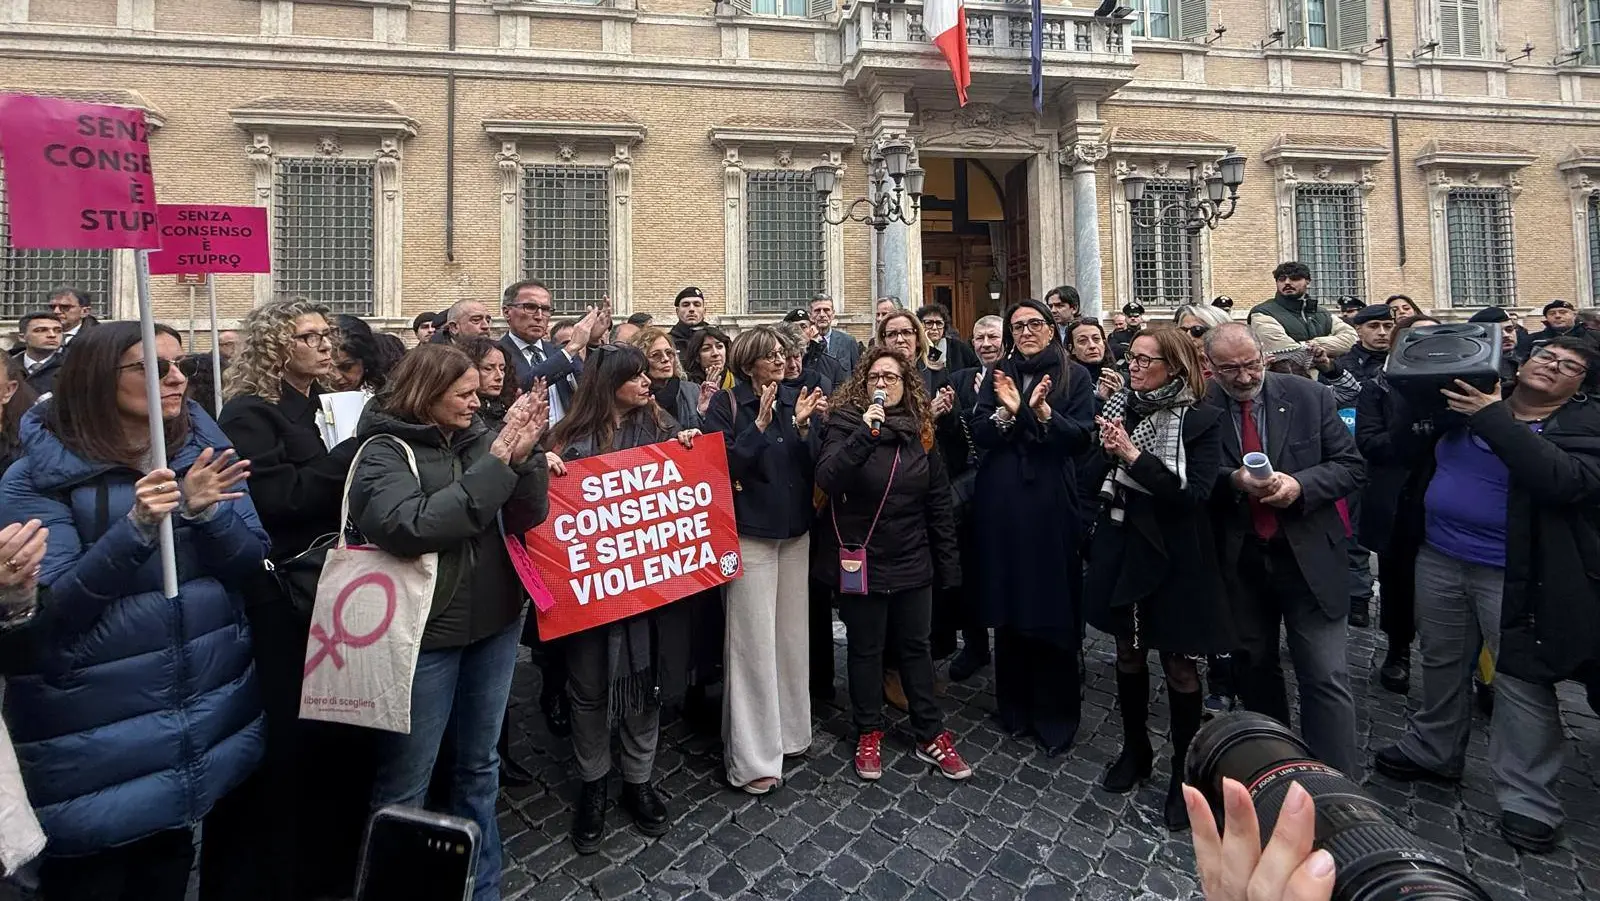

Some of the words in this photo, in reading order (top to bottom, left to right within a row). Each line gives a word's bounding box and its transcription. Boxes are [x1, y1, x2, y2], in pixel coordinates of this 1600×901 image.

[130, 177, 144, 204] È
[80, 209, 158, 232] STUP
[177, 210, 232, 222] SENZA
[161, 225, 252, 238] CONSENSO
[202, 238, 211, 251] È
[177, 254, 241, 268] STUPRO
[581, 459, 683, 502] SENZA
[554, 482, 712, 541] CONSENSO
[567, 538, 591, 573] È
[595, 512, 711, 564] SEMPRE
[569, 542, 718, 606] VIOLENZA
